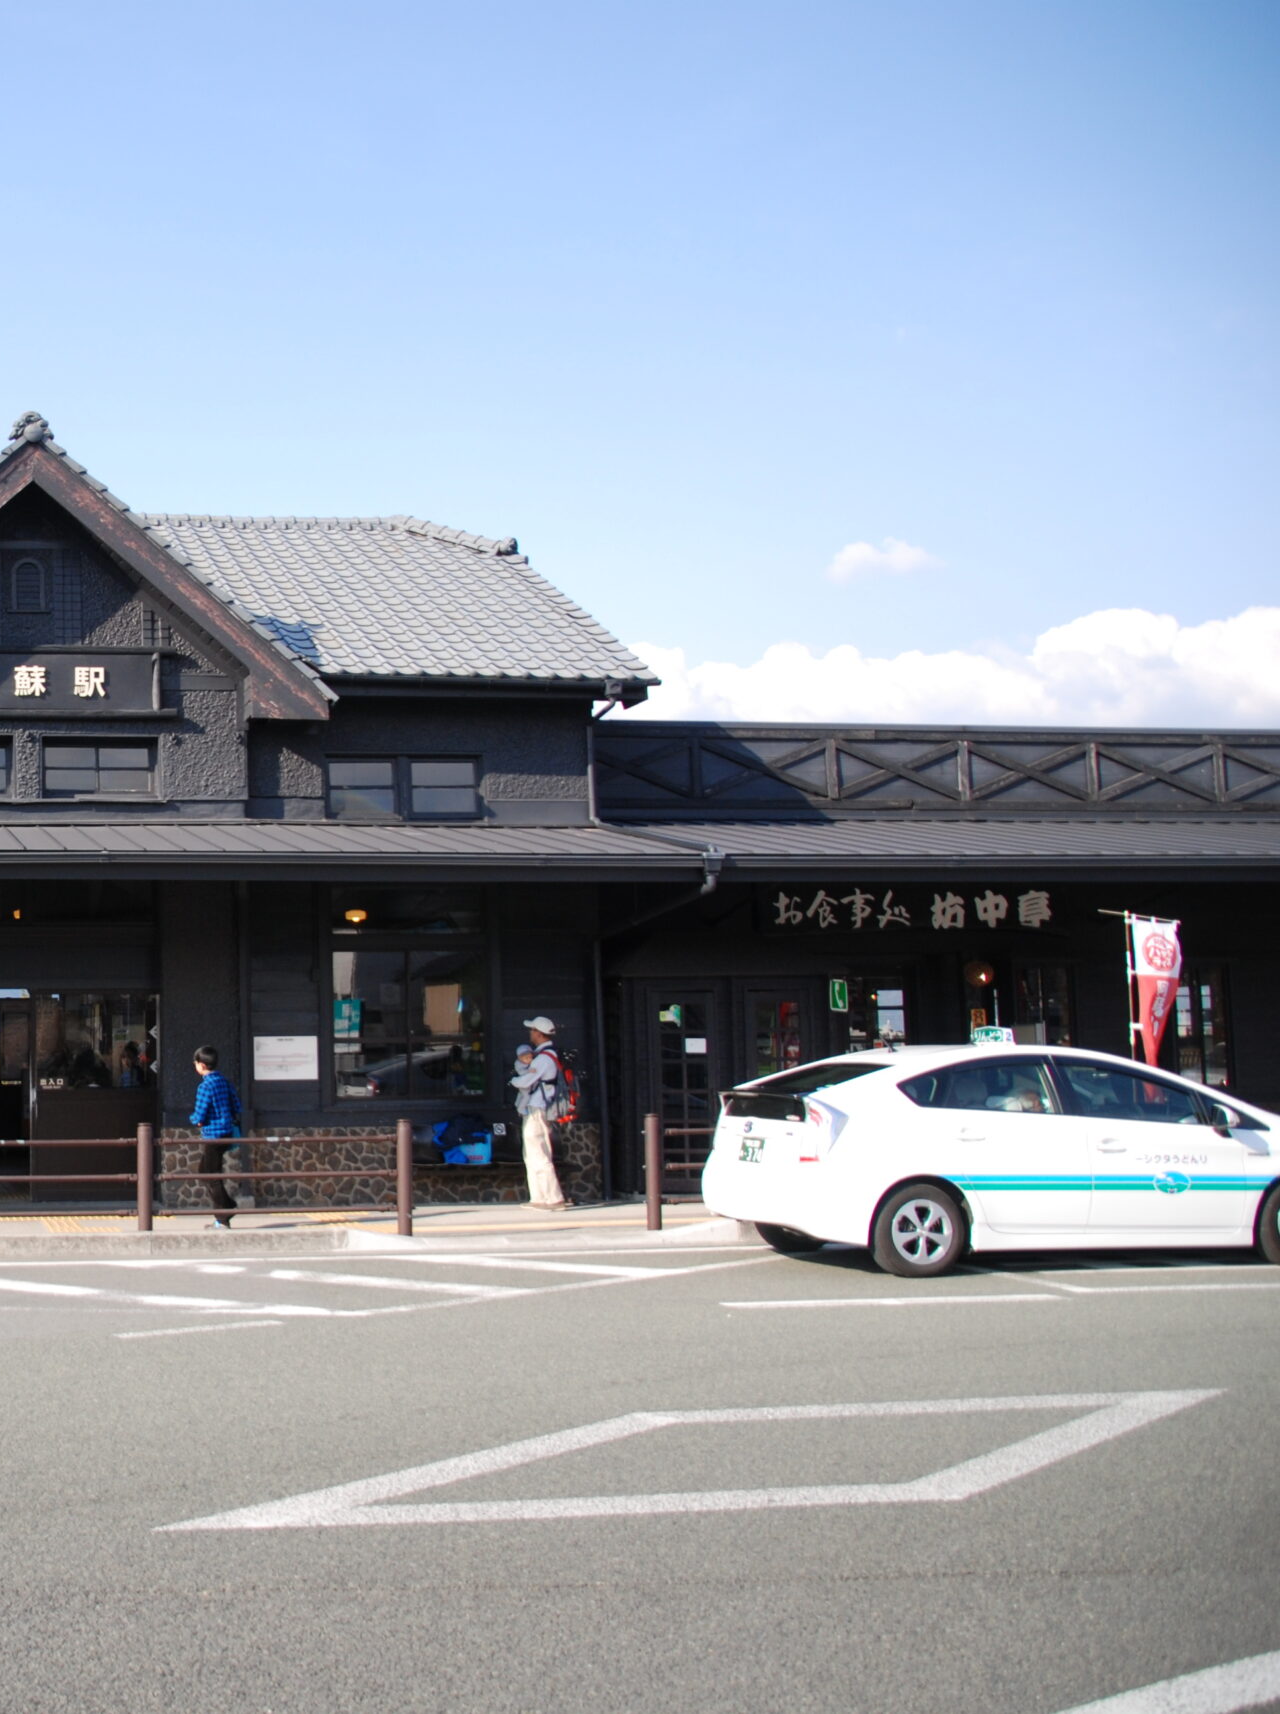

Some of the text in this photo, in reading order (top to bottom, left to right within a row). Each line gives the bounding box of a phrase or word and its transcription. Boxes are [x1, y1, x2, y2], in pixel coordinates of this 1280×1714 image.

[772, 888, 1052, 929] お食事処 坊中亭
[39, 1078, 64, 1086] 出入口
